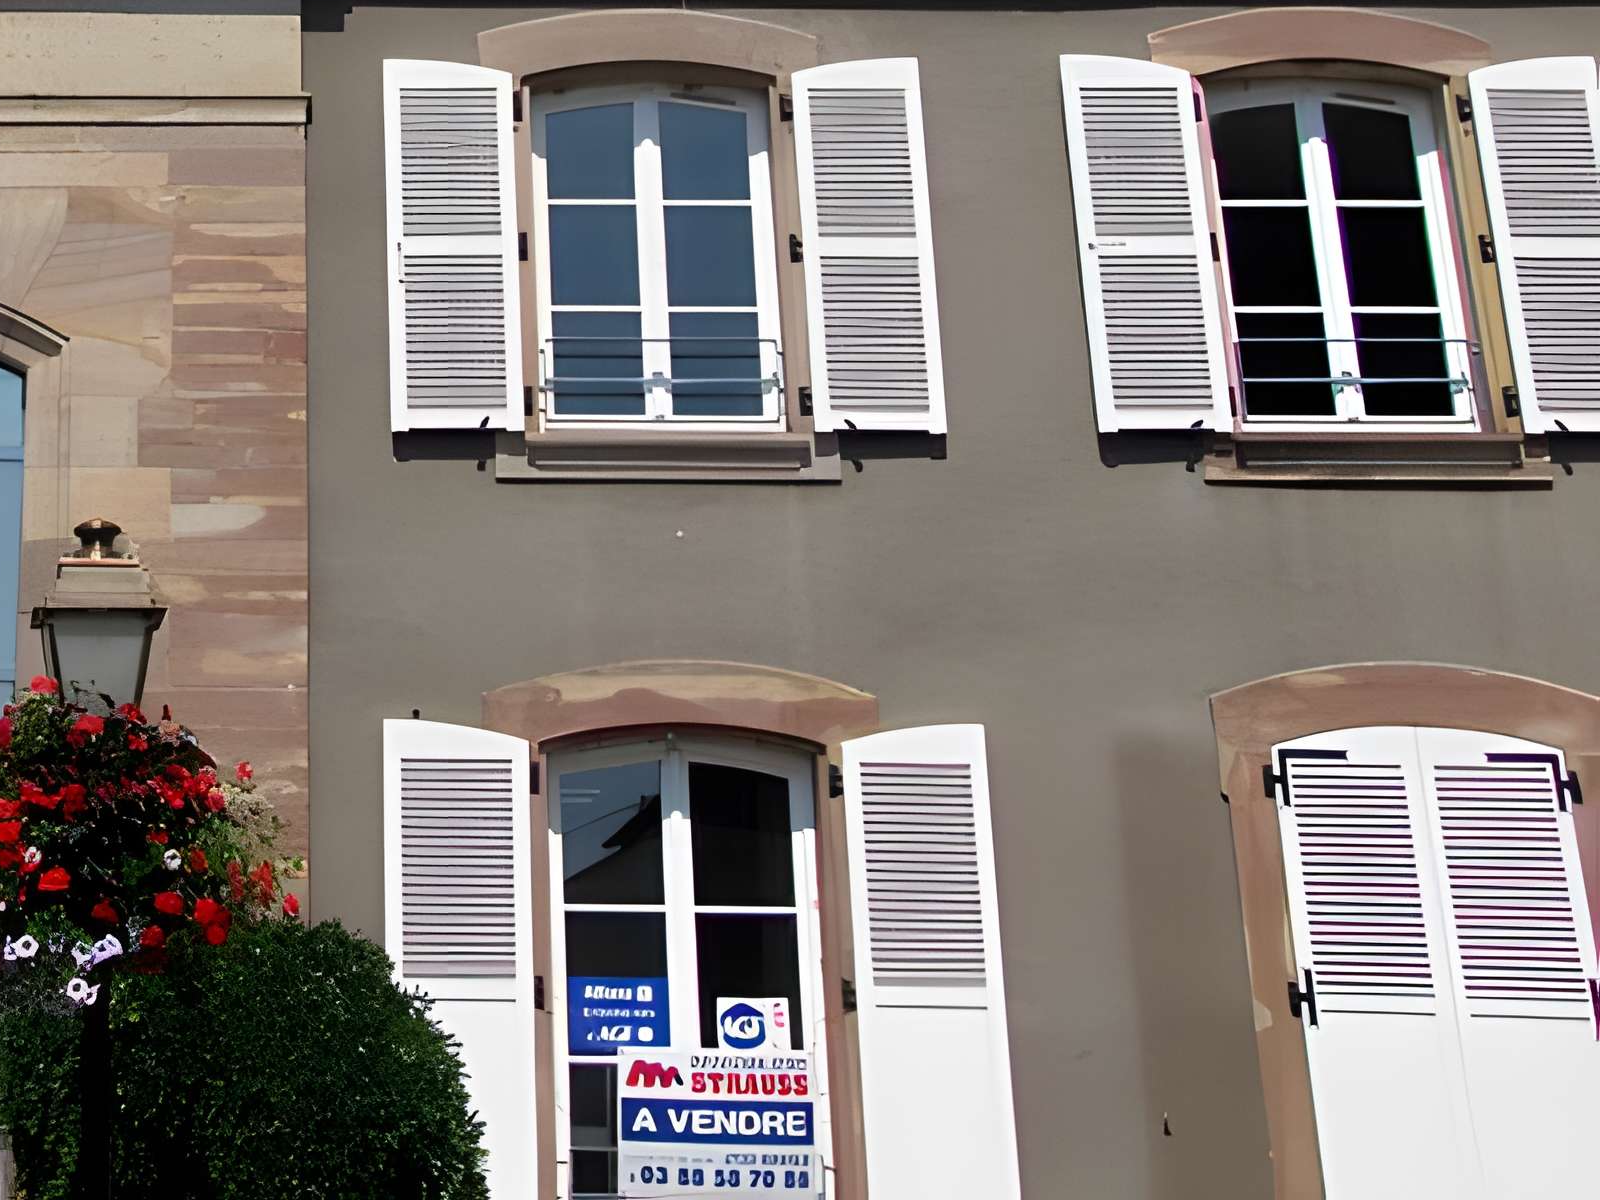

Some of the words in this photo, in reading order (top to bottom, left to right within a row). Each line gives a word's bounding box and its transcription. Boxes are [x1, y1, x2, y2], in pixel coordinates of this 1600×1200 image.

[632, 1108, 657, 1132] A
[668, 1109, 806, 1137] VENDRE
[750, 1170, 775, 1188] 70
